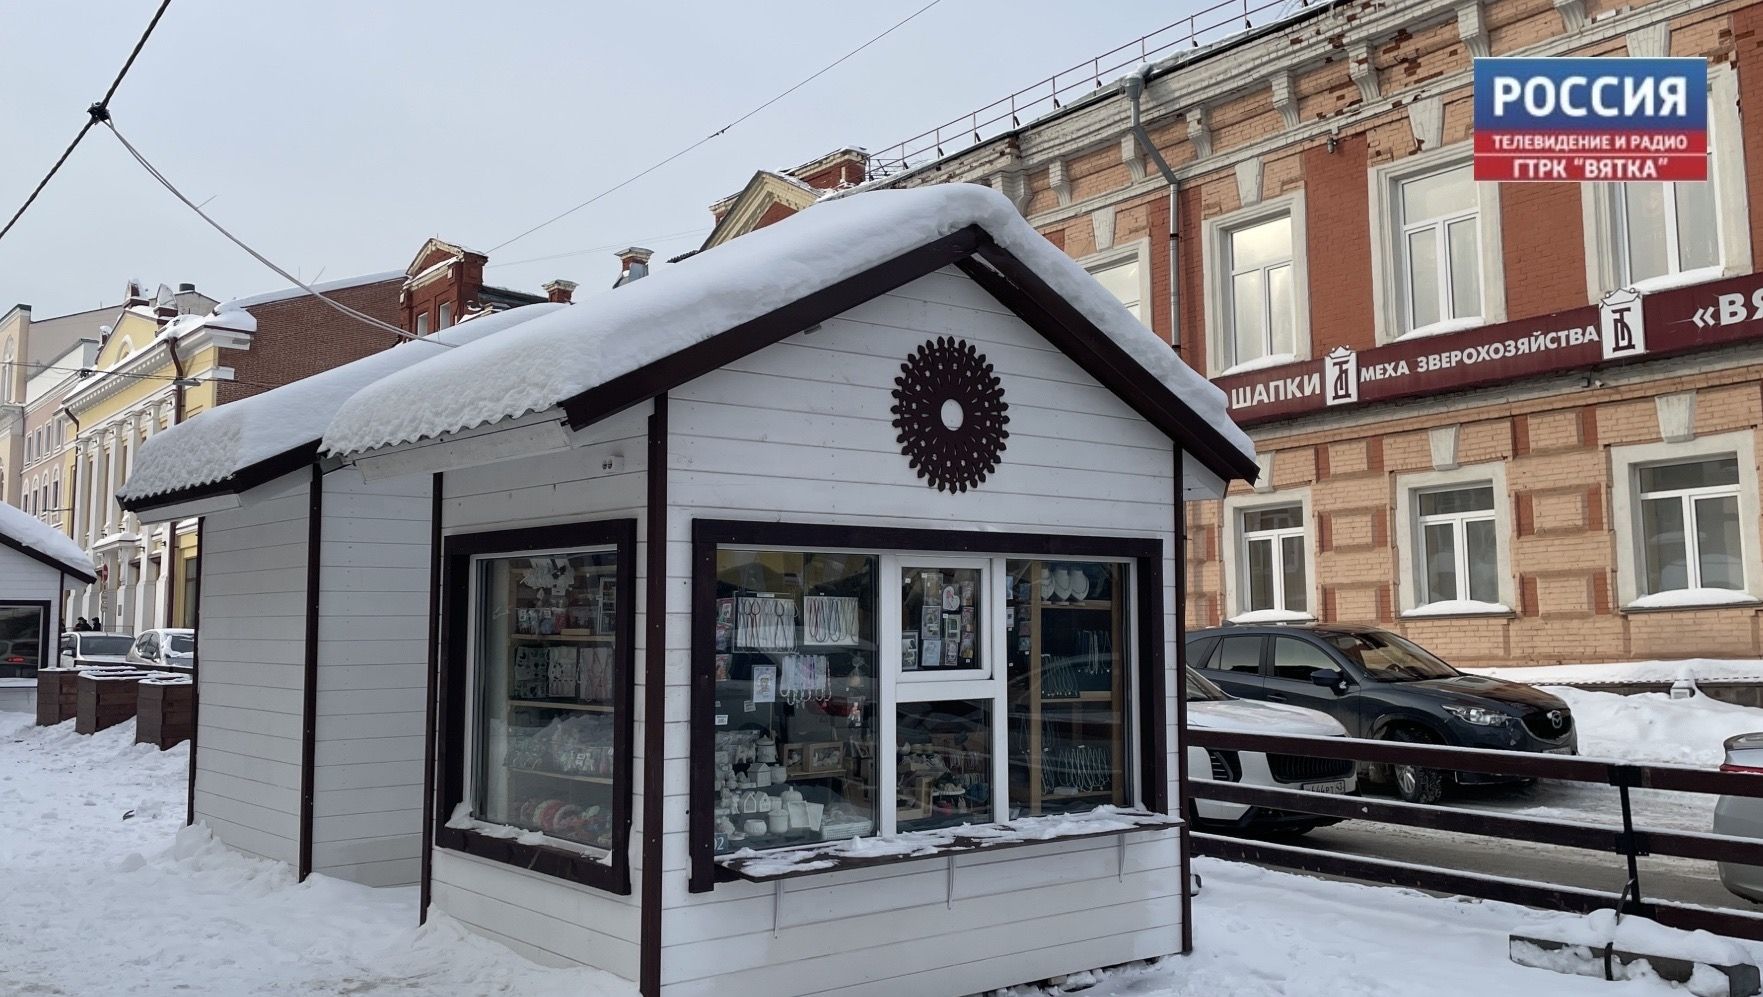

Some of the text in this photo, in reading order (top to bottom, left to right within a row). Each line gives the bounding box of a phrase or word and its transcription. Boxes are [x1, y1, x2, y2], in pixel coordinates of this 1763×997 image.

[1231, 325, 1600, 409] ШАПКИ МЕХА ЗВЕРОХОЗЯЙСТВА
